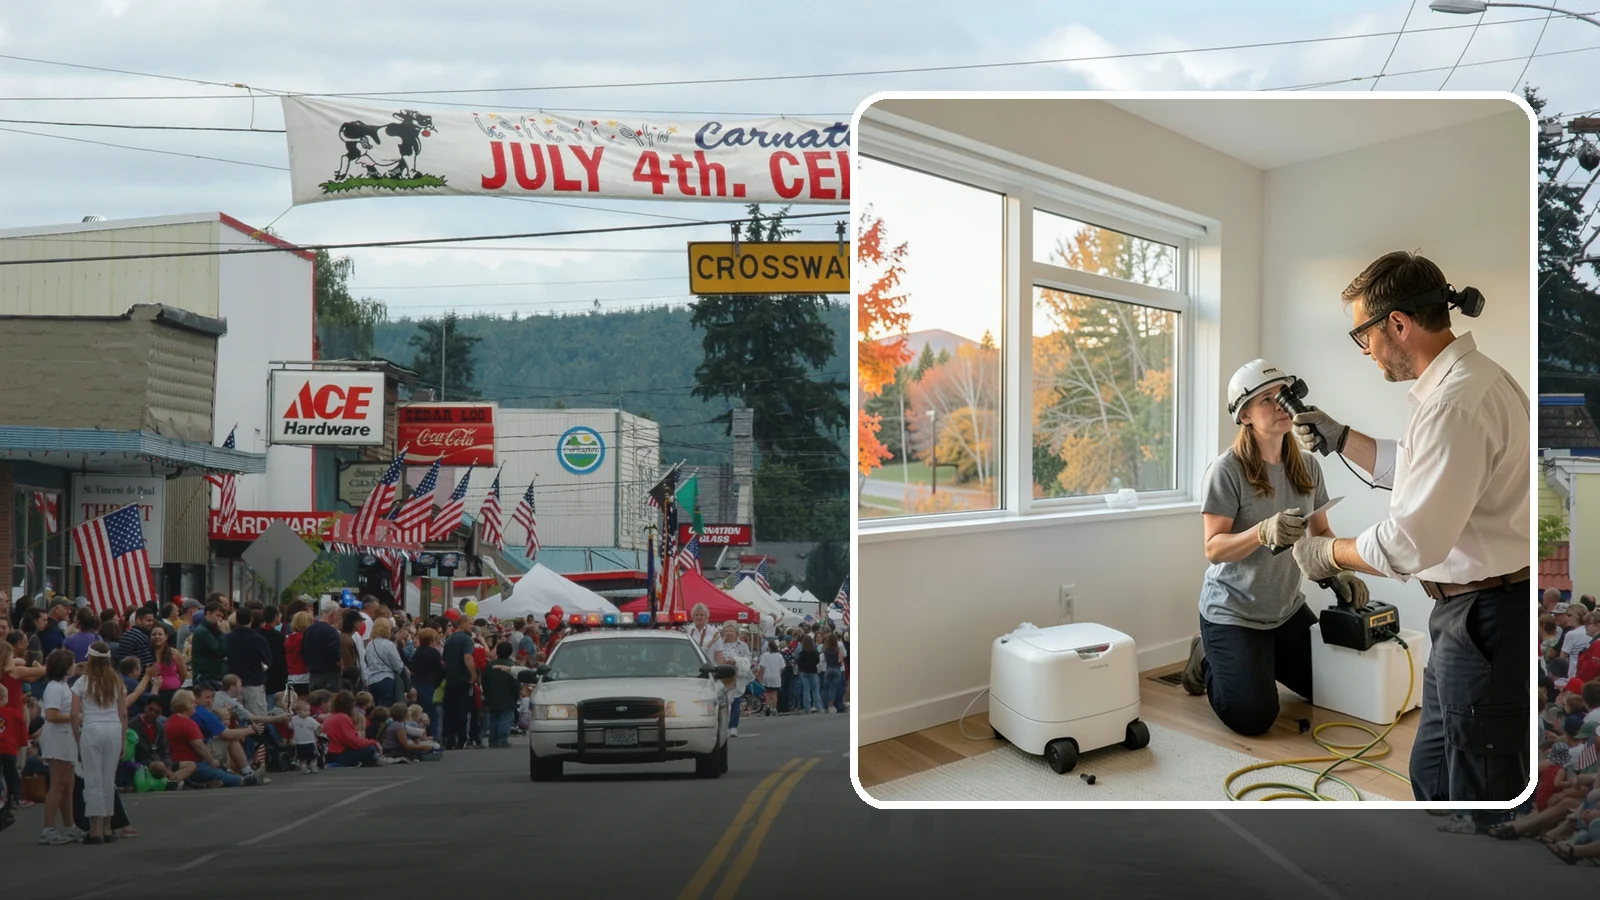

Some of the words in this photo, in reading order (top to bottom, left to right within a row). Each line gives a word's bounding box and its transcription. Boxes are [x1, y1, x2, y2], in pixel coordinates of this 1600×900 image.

[695, 121, 850, 150] Carnat
[481, 141, 605, 192] JULY
[632, 150, 747, 197] 4th.
[696, 254, 850, 280] CROSSWA
[282, 380, 374, 420] ACE
[405, 409, 453, 422] CEDAR
[283, 421, 371, 436] Hardware
[416, 427, 477, 447] Coca-Cola
[83, 484, 94, 494] St.
[95, 485, 124, 495] Vincent
[126, 485, 136, 495] de
[137, 486, 155, 495] Paul
[81, 502, 154, 522] THRT
[688, 526, 741, 535] CRNATION
[699, 535, 730, 543] GLASS
